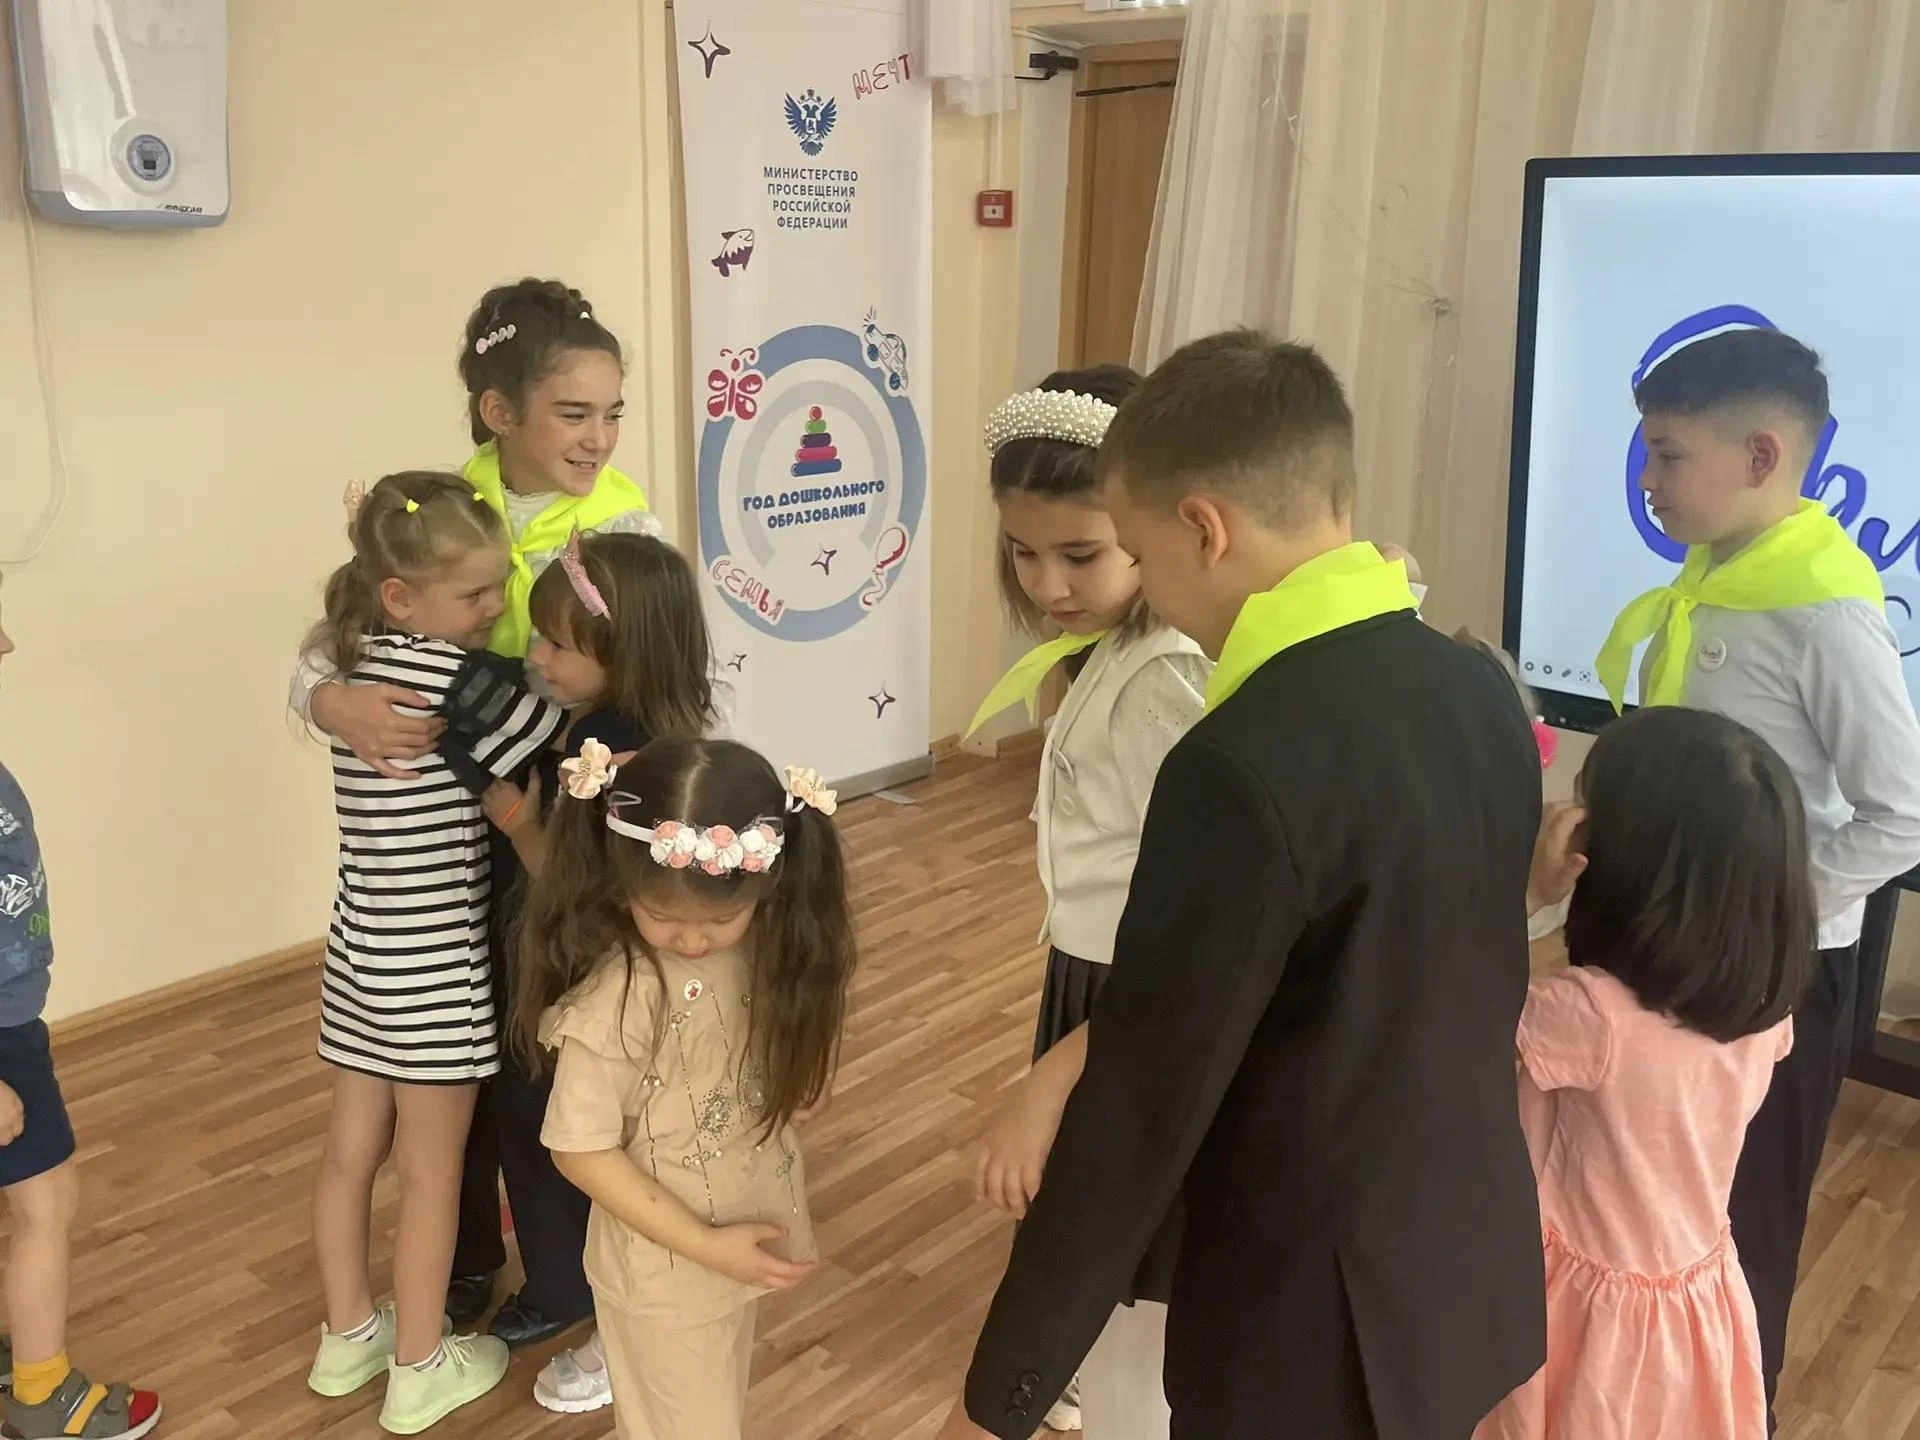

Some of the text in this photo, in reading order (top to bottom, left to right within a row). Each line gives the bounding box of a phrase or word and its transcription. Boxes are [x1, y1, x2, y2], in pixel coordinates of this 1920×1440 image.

[763, 166, 859, 182] МИНИСТЕРСТВО
[767, 183, 856, 198] ПРОСВЕЩЕНИЯ
[772, 199, 851, 214] РОССИЙСКОЙ
[776, 216, 848, 230] ФЕДЕРАЦИИ
[743, 479, 886, 512] ГОД ДОШКОЛЬНОГО
[767, 501, 866, 529] ОБРАЗОВАНИЯ
[712, 559, 785, 622] СЕМЬЯ
